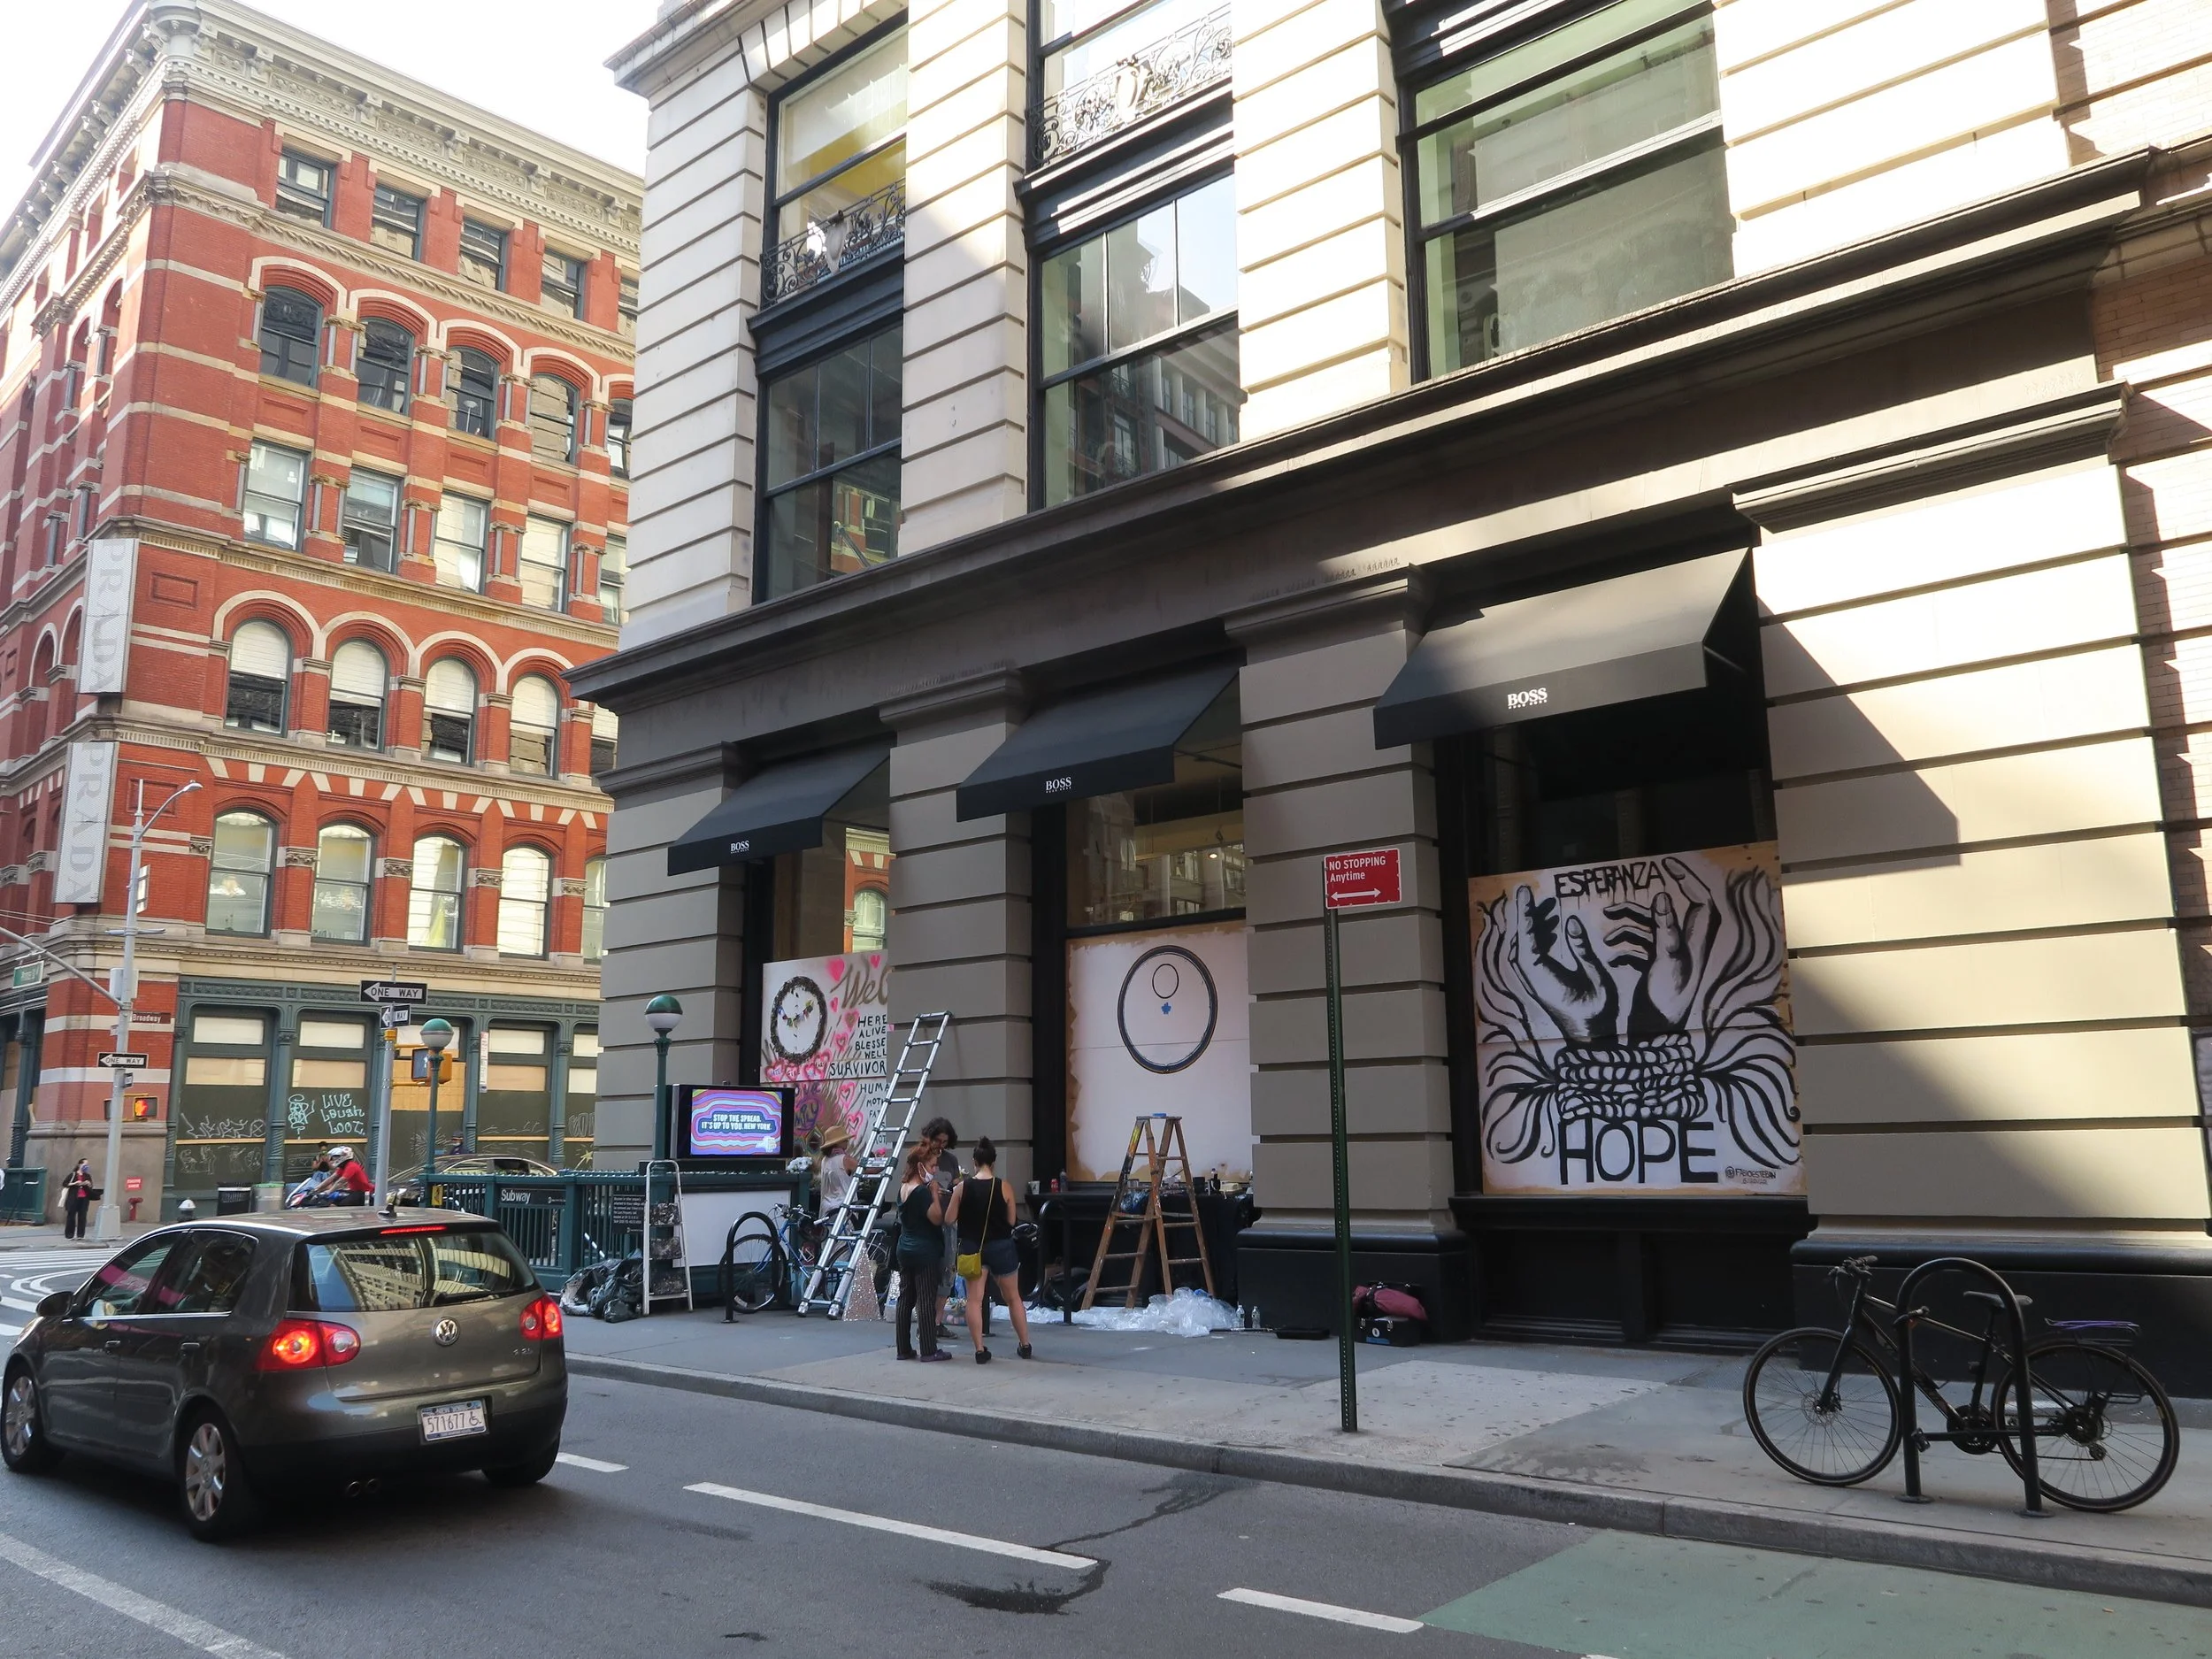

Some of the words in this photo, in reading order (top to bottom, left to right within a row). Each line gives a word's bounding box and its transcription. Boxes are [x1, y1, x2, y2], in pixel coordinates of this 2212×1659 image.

[88, 540, 127, 692] PRADA
[1507, 687, 1548, 707] BOSS
[1046, 776, 1071, 791] BOSS
[65, 742, 105, 901] PRADA
[730, 840, 749, 852] BOSS
[1329, 860, 1341, 871] NO
[1343, 856, 1386, 870] STOPPING
[1330, 871, 1365, 883] Anytime
[1554, 860, 1666, 898] ESPERANZA
[371, 987, 389, 997] ONE
[398, 988, 419, 998] WAY
[133, 1013, 161, 1023] Broadway
[857, 1014, 887, 1027] HERE
[859, 1025, 887, 1038] ALIVE
[864, 1048, 887, 1059] WELL
[829, 1060, 887, 1077] SURVIVOR
[322, 1093, 352, 1109] LIVE
[712, 1113, 728, 1122] STOP
[728, 1114, 740, 1123] THE
[744, 1122, 757, 1131] NEW
[1558, 1117, 1719, 1186] HOPE
[501, 1188, 531, 1204] Subway
[426, 1412, 465, 1433] 571677
